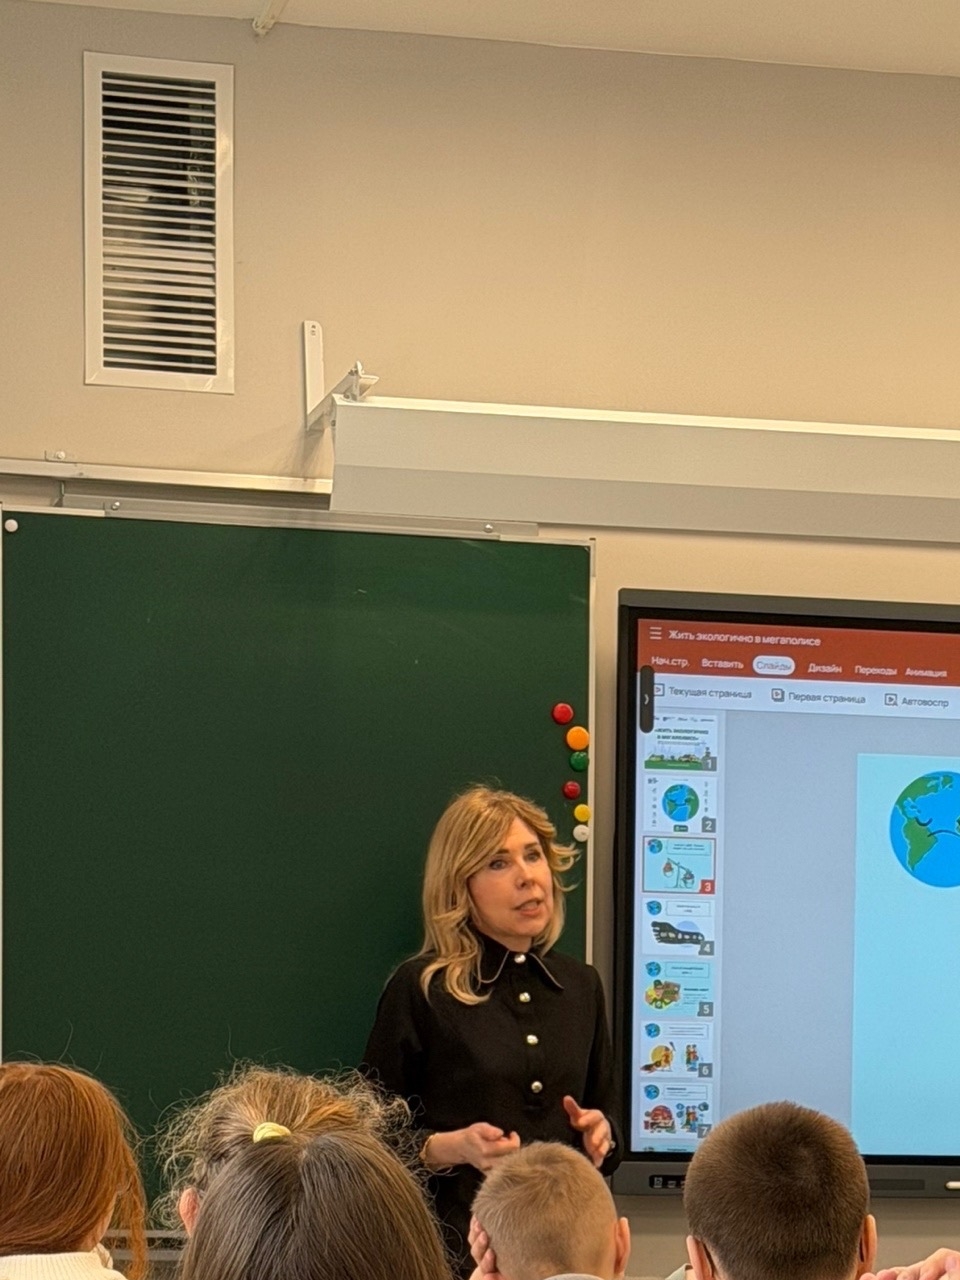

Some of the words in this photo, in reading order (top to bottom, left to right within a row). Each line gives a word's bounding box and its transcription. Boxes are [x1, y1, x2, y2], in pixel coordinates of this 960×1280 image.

[669, 630, 695, 640] Жить
[696, 633, 753, 643] экологично
[762, 636, 821, 646] мегаполисе
[651, 656, 690, 668] Нач.стр.
[701, 658, 744, 669] Вставить
[756, 660, 792, 672] Слайды
[808, 663, 843, 674] Дизайн
[854, 665, 898, 676] Переходы
[905, 667, 948, 679] Анимация
[669, 686, 707, 697] Текущая
[708, 689, 752, 700] страница
[788, 692, 822, 702] Первая
[823, 694, 866, 704] страница
[901, 697, 949, 708] Автовоспр
[705, 821, 713, 830] 2
[705, 882, 711, 892] 3
[703, 943, 711, 952] 4
[703, 1005, 710, 1014] 5
[702, 1065, 709, 1075] 6
[701, 1127, 708, 1136] 7
